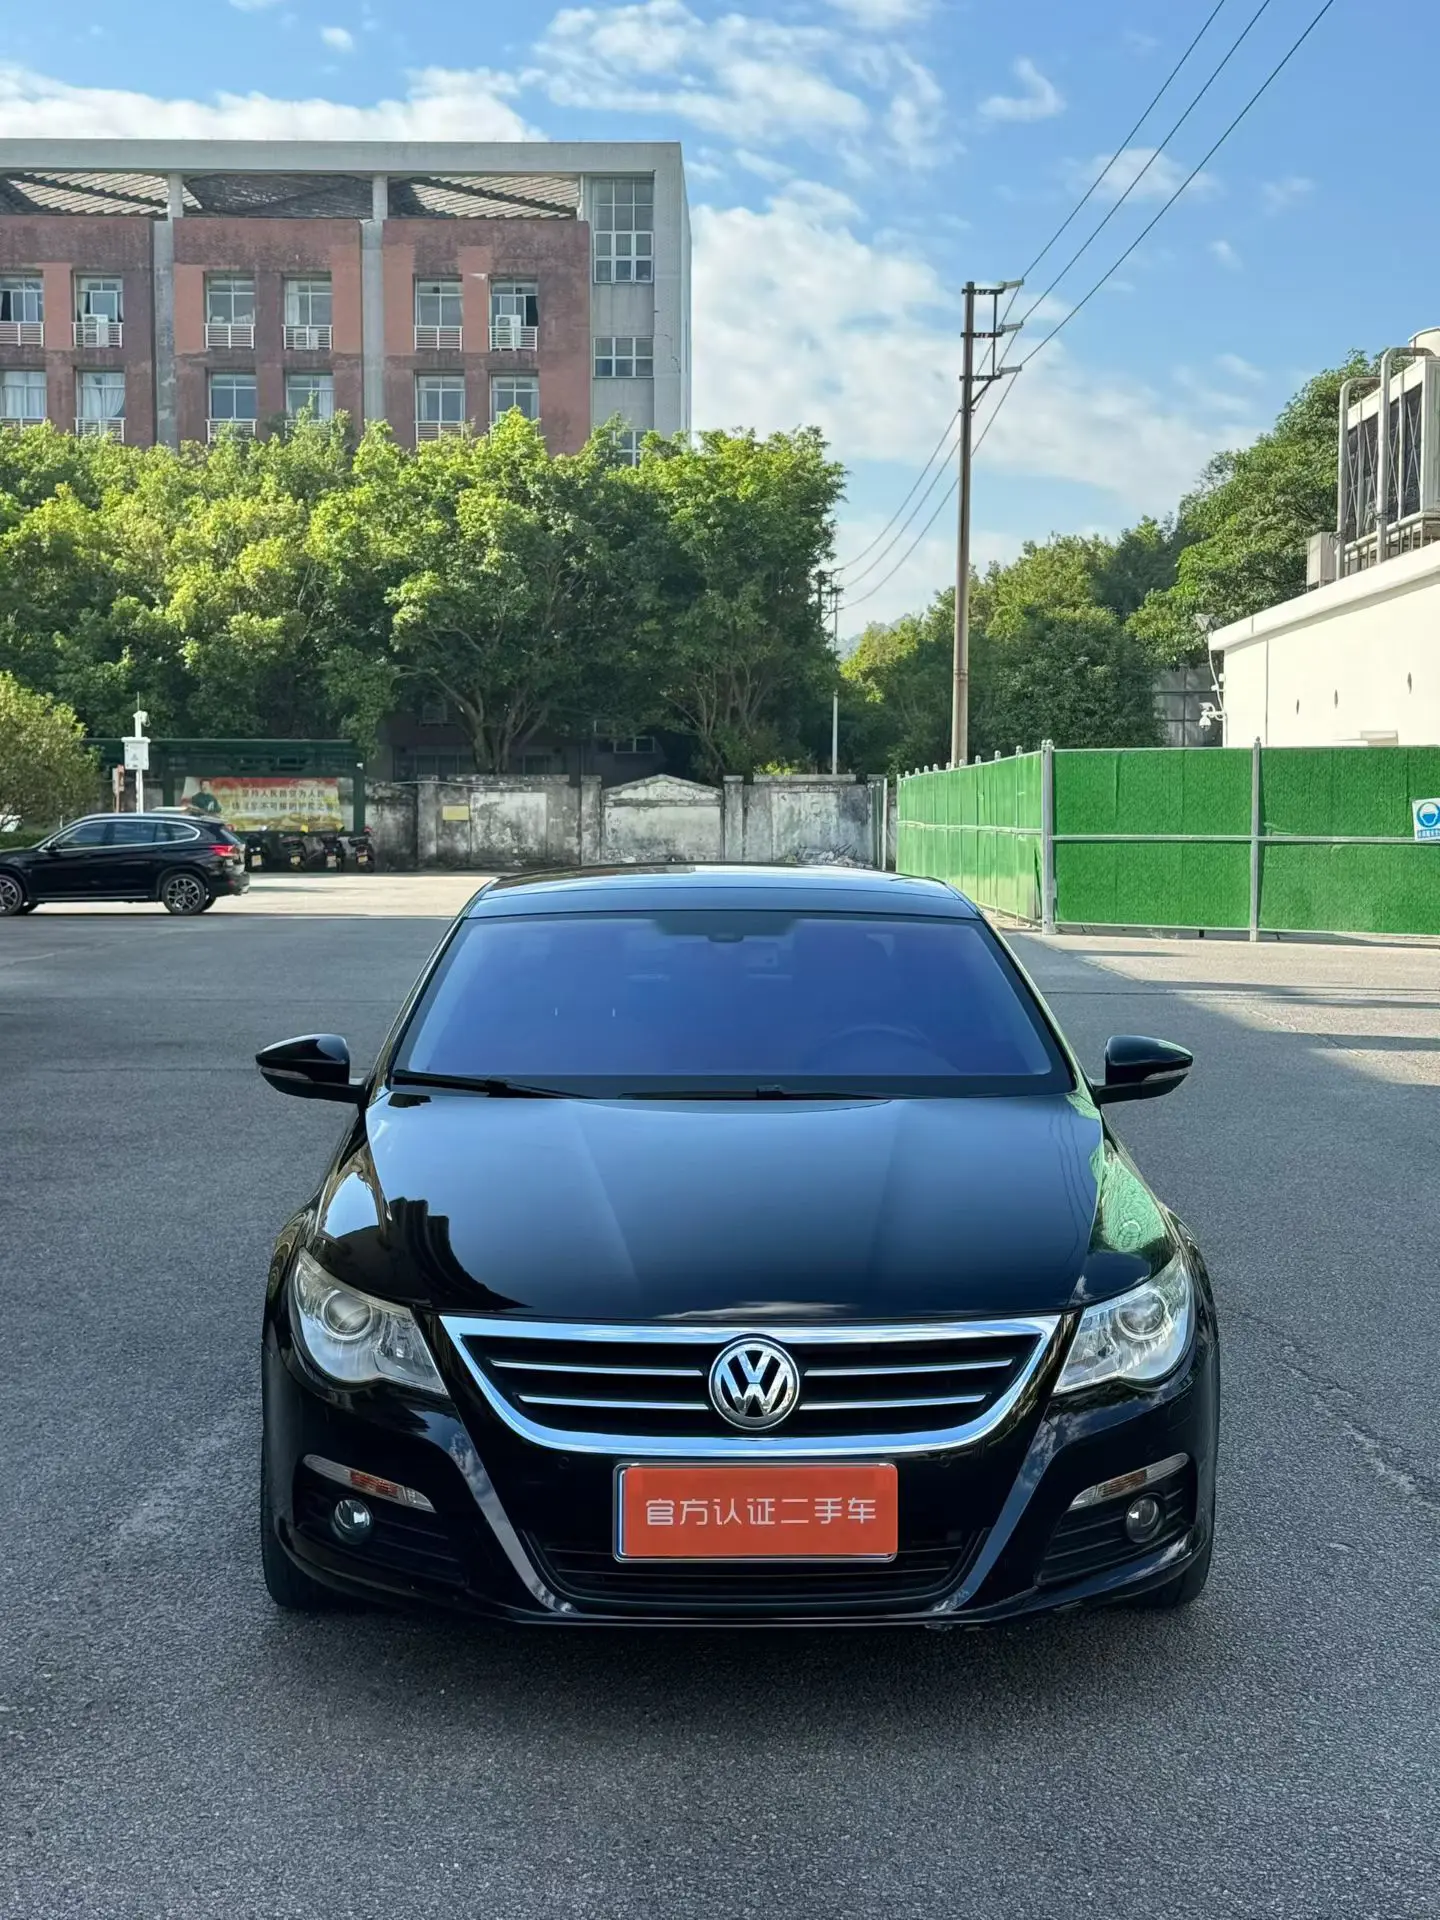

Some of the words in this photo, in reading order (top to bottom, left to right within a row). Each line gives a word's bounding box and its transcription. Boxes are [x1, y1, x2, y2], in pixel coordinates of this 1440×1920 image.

[714, 1343, 794, 1425] VW
[646, 1497, 877, 1526] 官方认证二手车
